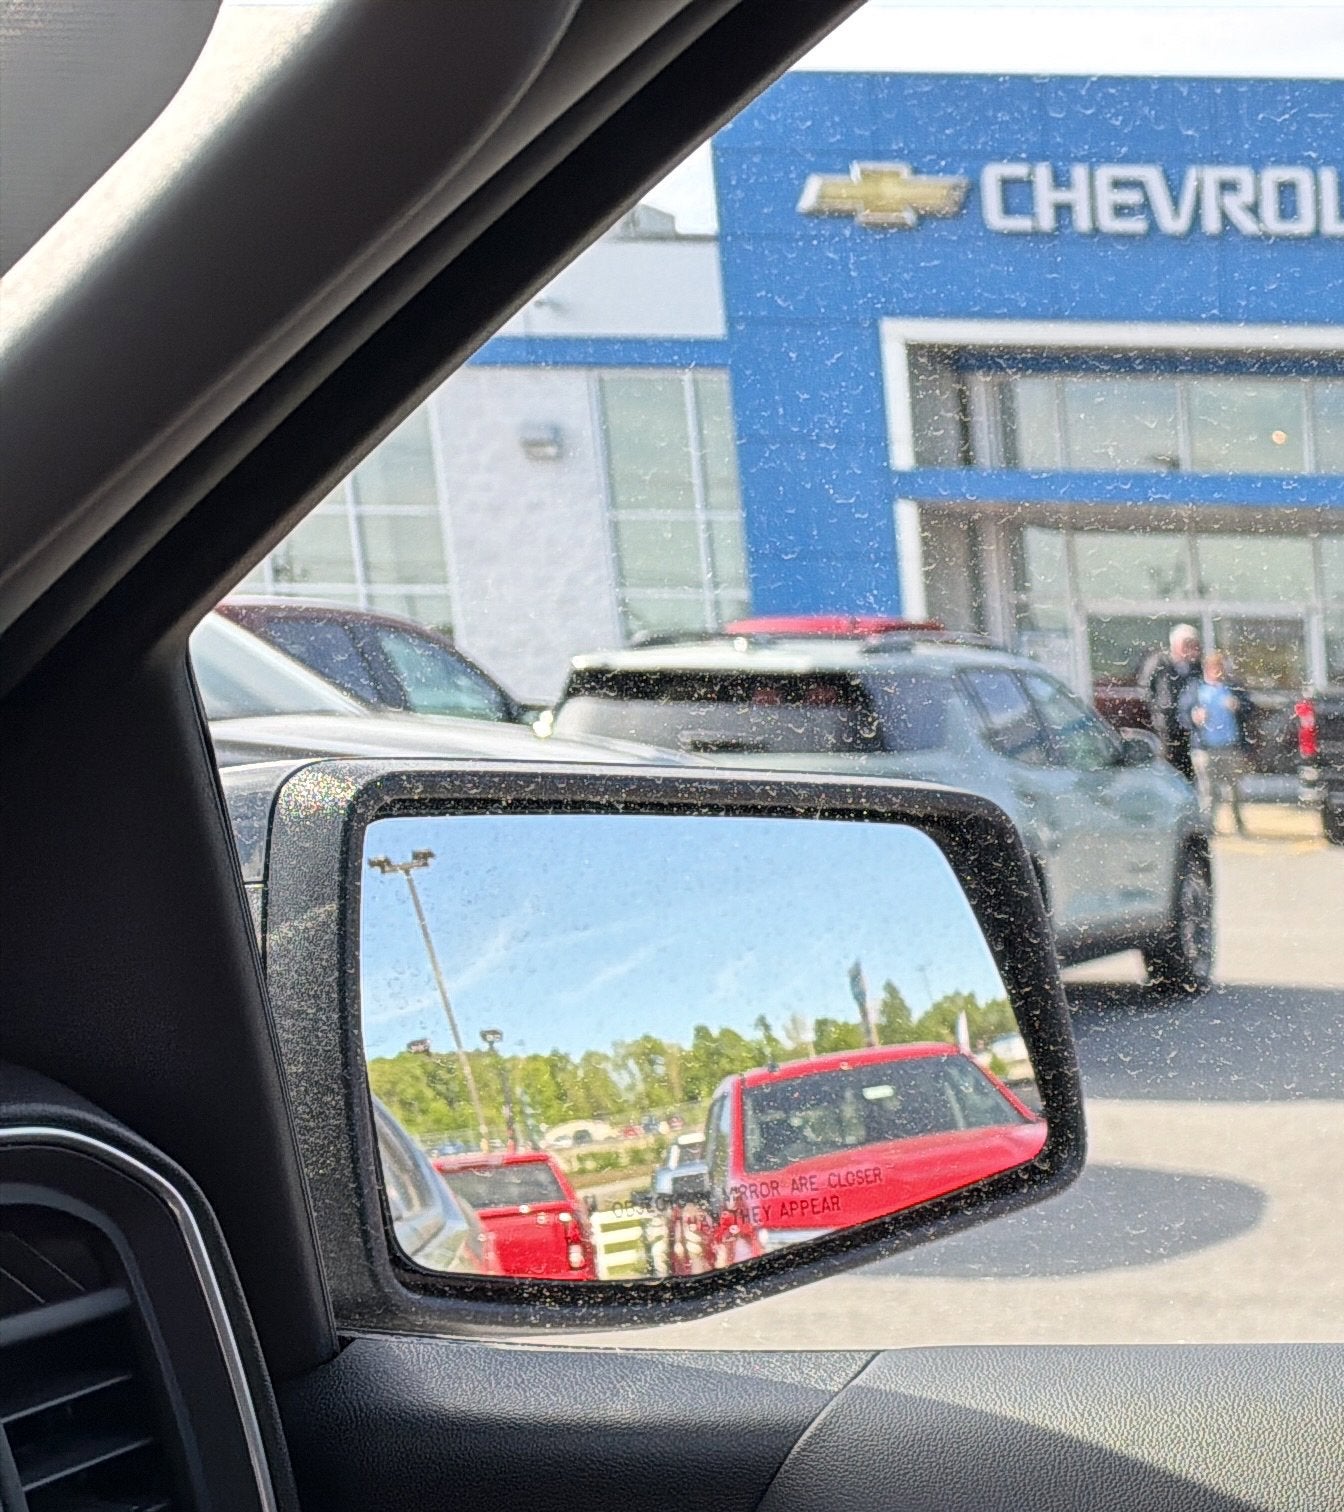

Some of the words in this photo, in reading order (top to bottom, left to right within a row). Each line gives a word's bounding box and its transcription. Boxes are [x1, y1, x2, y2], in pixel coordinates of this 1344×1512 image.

[791, 1175, 819, 1194] ARE
[827, 1167, 882, 1188] CLOSER
[780, 1195, 841, 1217] APPEAR
